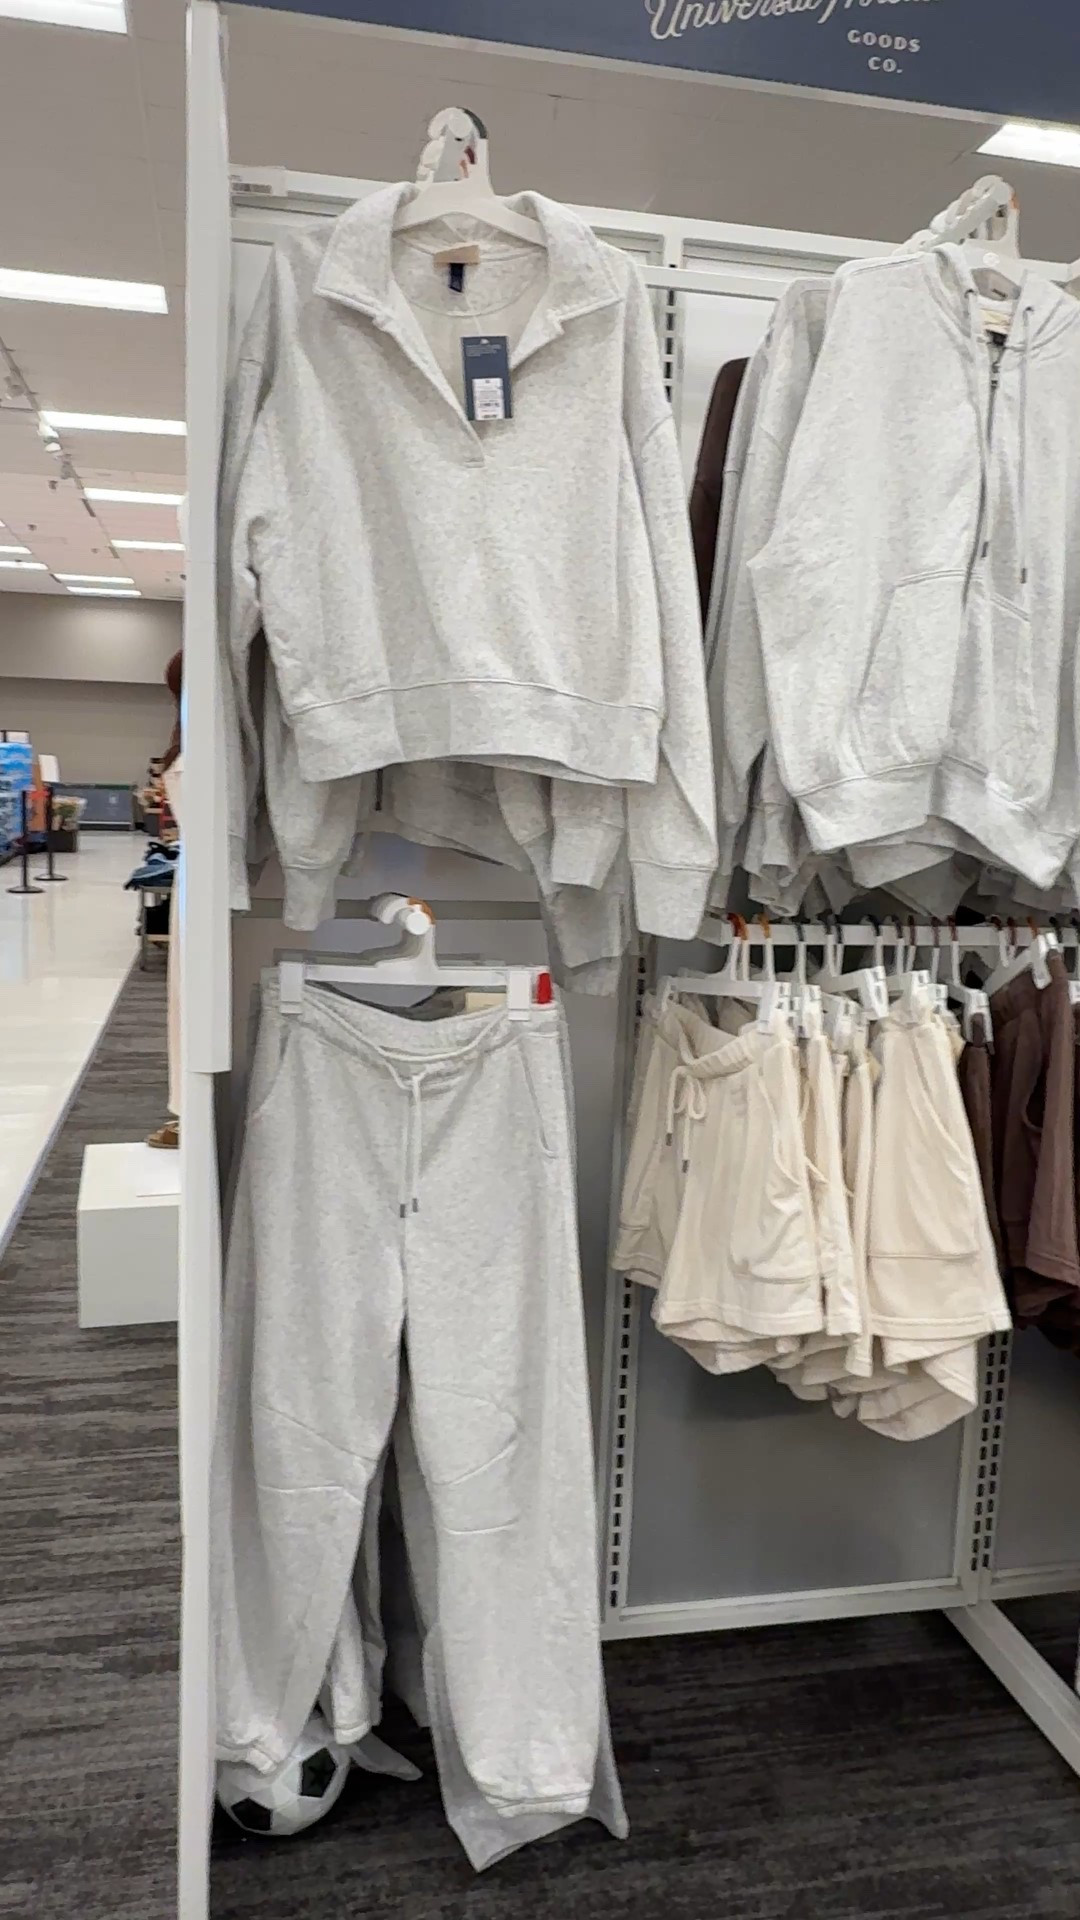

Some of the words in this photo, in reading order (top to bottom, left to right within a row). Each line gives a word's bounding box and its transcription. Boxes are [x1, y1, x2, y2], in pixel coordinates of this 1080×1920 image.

[644, 0, 817, 39] Universa
[847, 29, 920, 53] GOODS
[868, 56, 903, 74] CO.
